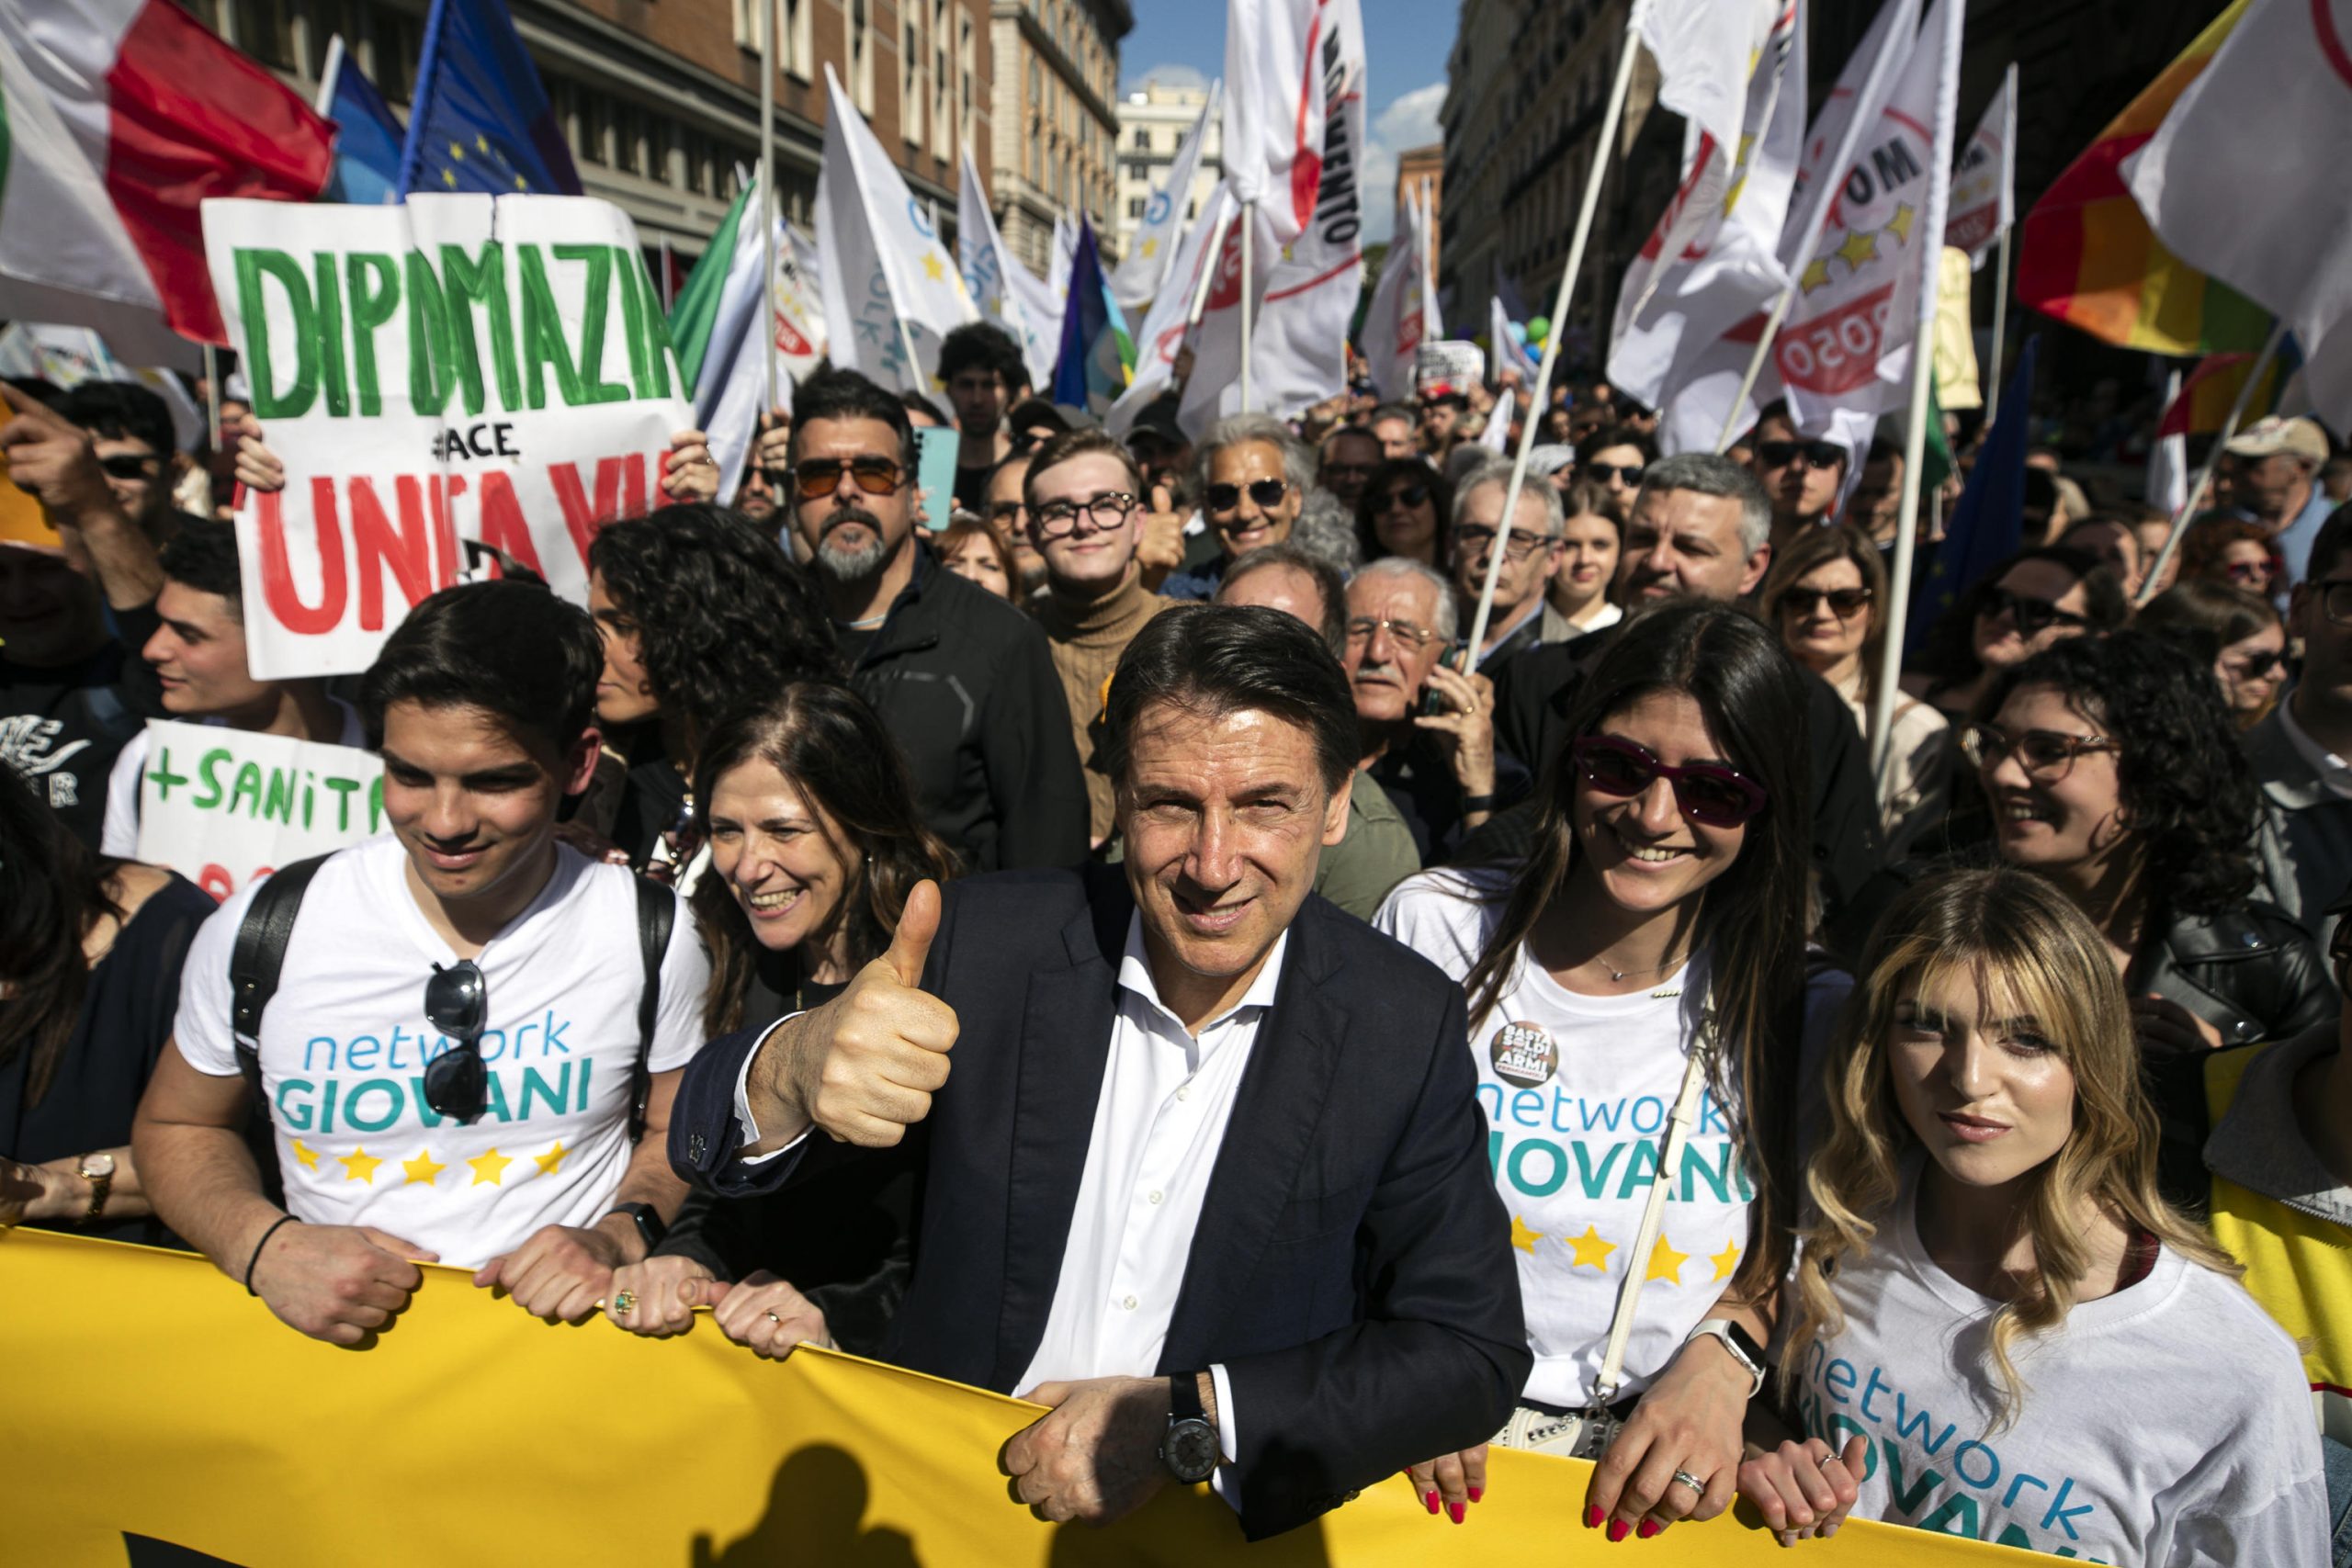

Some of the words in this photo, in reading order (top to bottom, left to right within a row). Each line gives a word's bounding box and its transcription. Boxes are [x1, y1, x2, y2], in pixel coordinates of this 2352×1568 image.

[1498, 1051, 1548, 1072] ARMI
[1476, 1083, 1729, 1134] netwok
[1807, 1337, 2094, 1540] network
